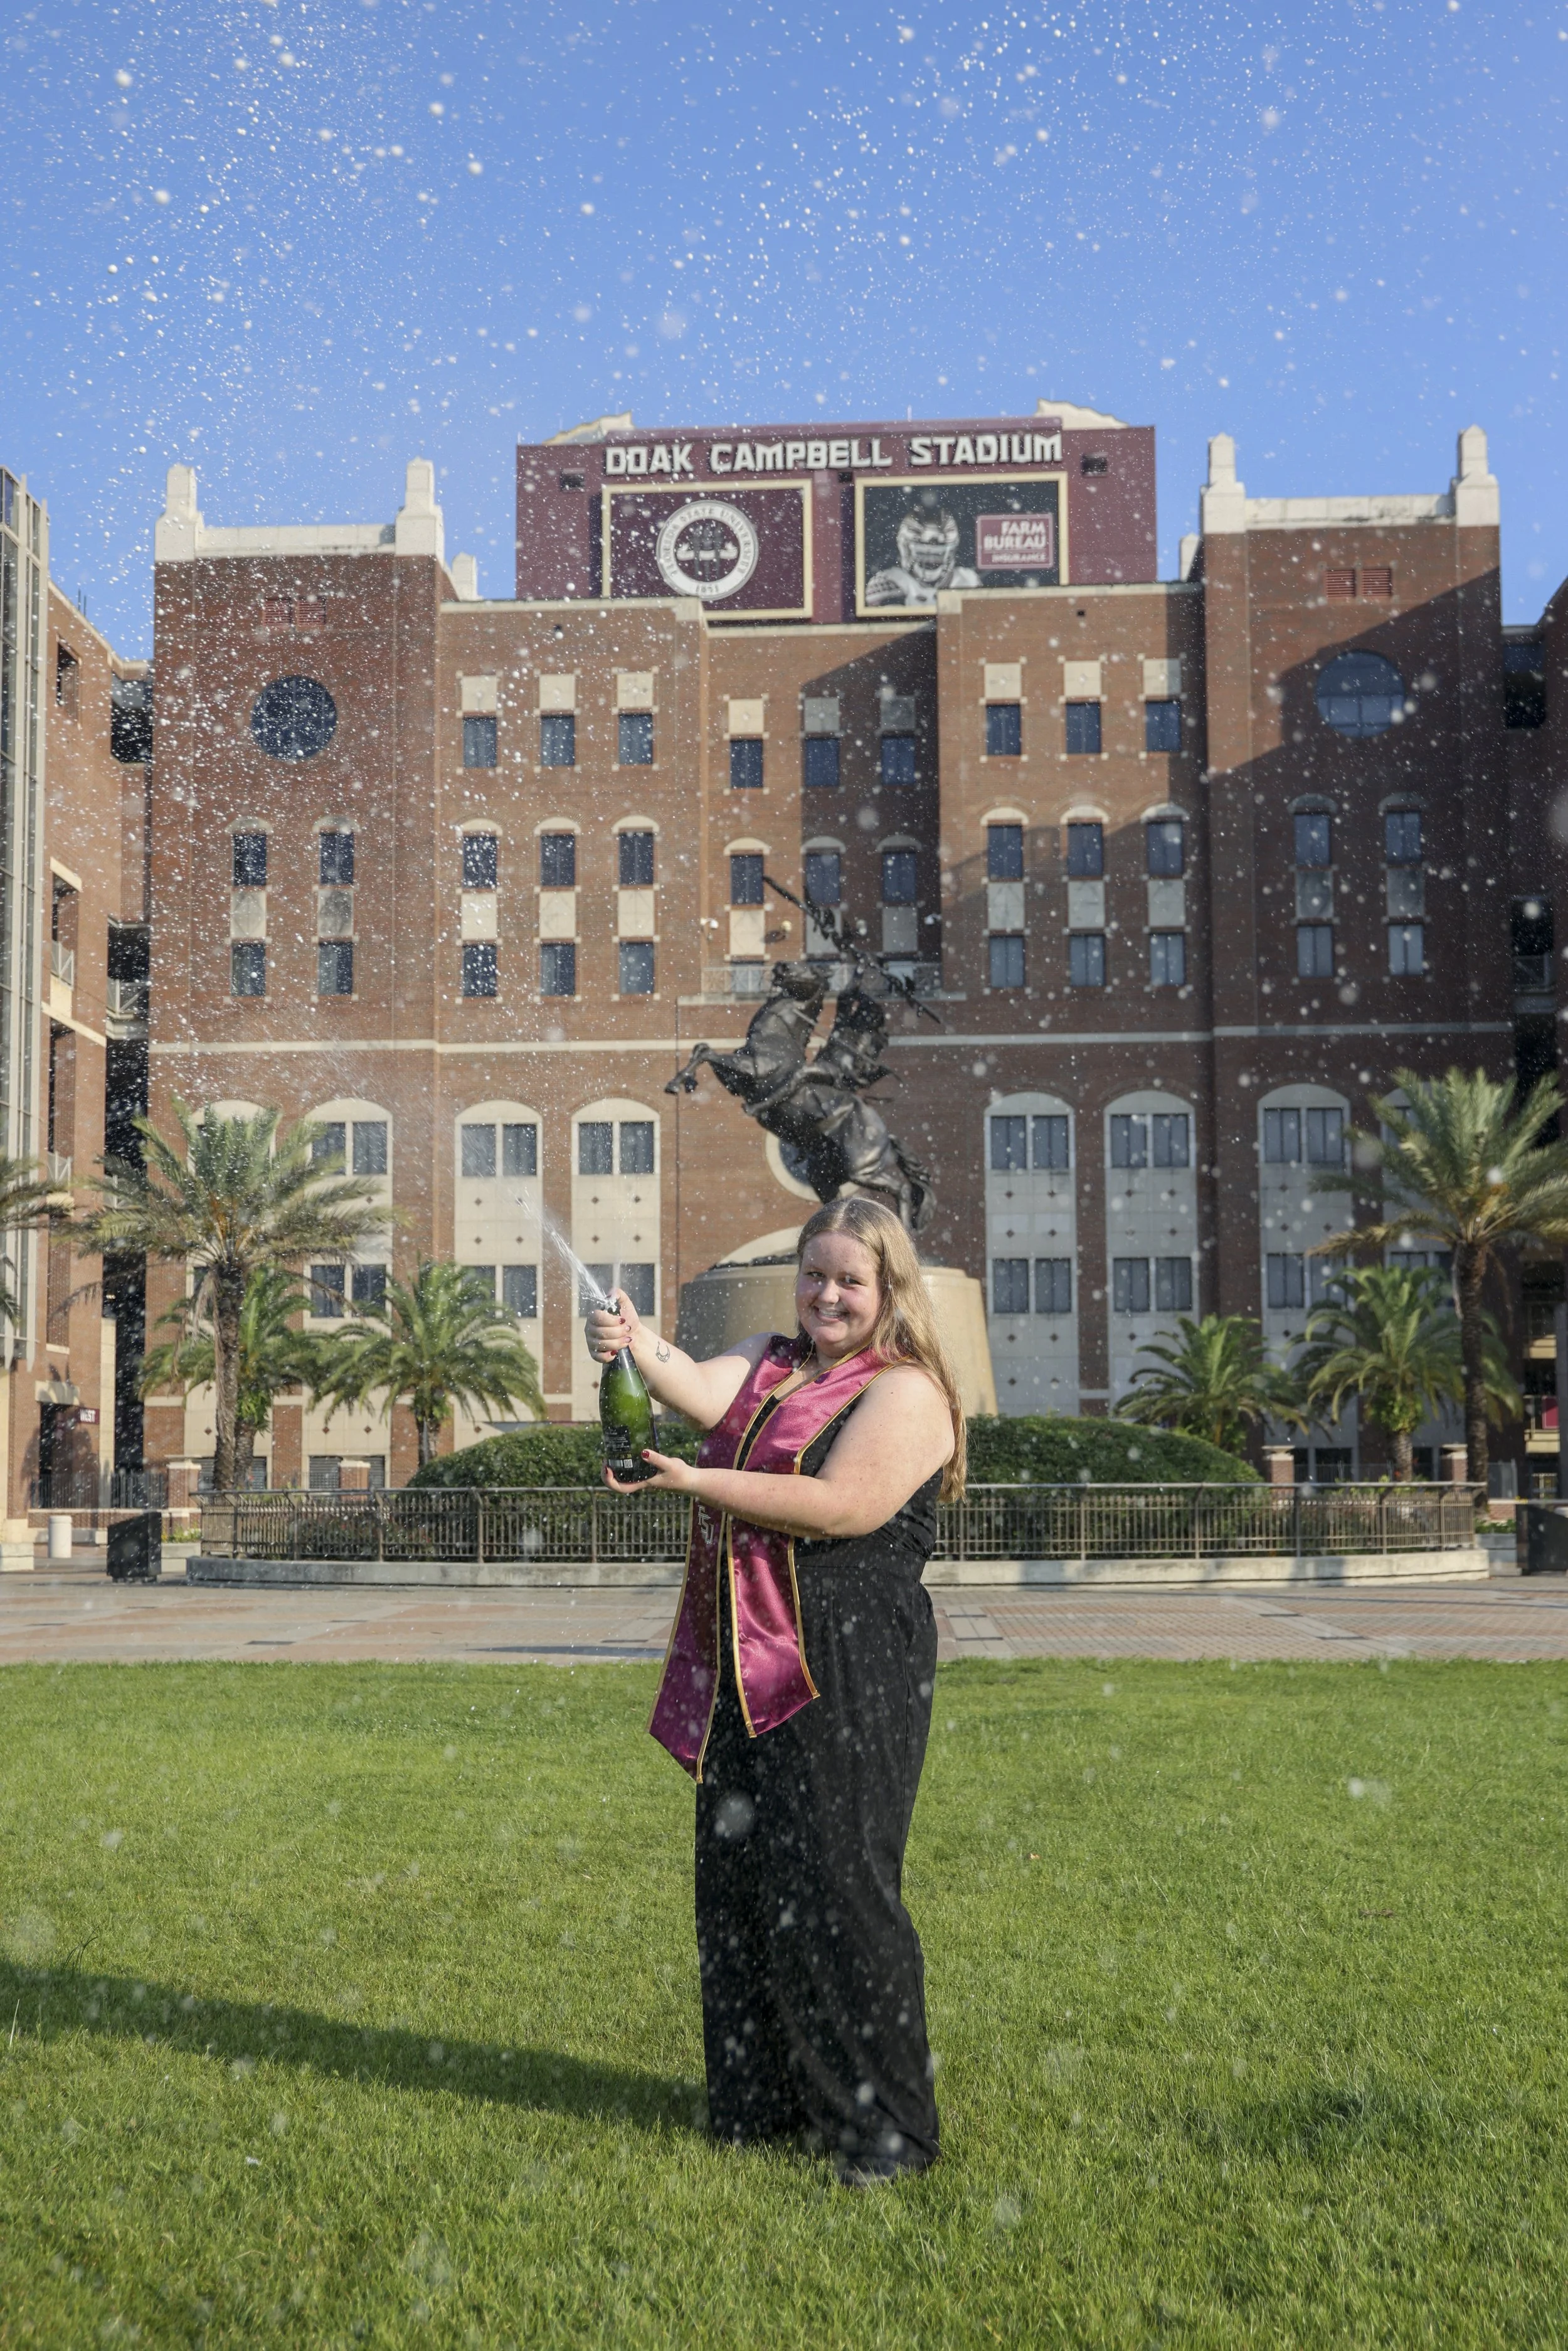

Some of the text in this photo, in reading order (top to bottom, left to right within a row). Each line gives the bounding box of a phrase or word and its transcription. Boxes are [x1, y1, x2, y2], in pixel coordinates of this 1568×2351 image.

[606, 433, 1062, 475] DOAK CAMPBELL STADIUM
[1001, 520, 1046, 535] FARM
[983, 534, 1047, 550] BUREAU
[991, 551, 1047, 563] INSURANCE
[697, 1505, 714, 1544] FSU
